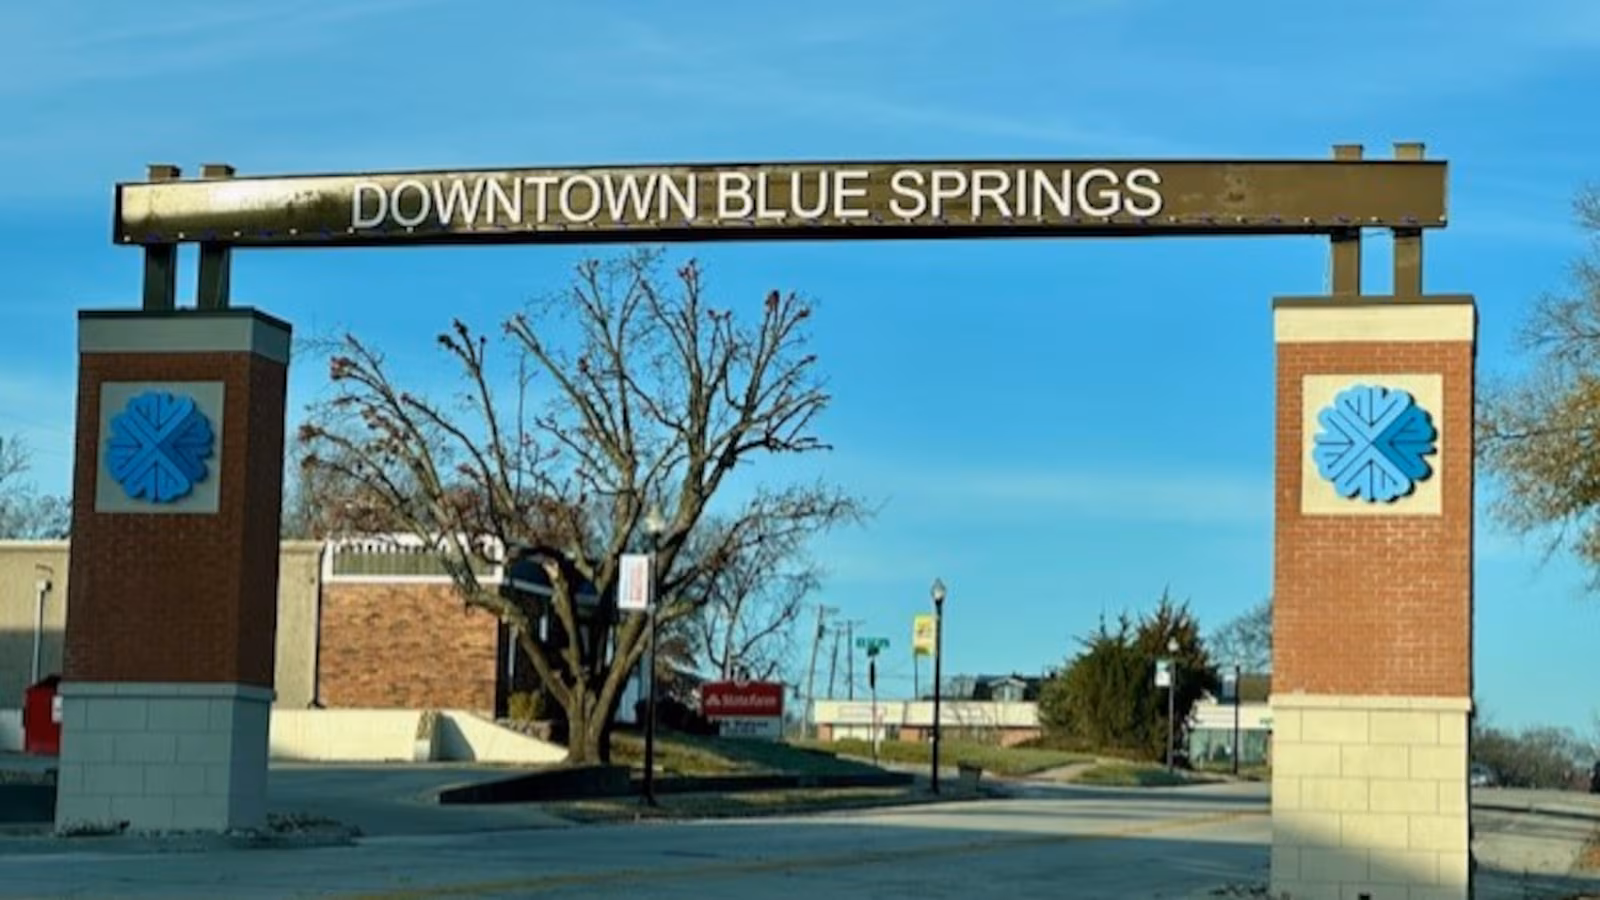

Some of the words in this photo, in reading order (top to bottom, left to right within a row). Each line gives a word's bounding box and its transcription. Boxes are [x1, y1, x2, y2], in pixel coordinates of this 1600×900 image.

[351, 173, 697, 229] DOWNTOWN
[717, 171, 870, 221] BLUE
[888, 169, 1163, 219] SPRINGS
